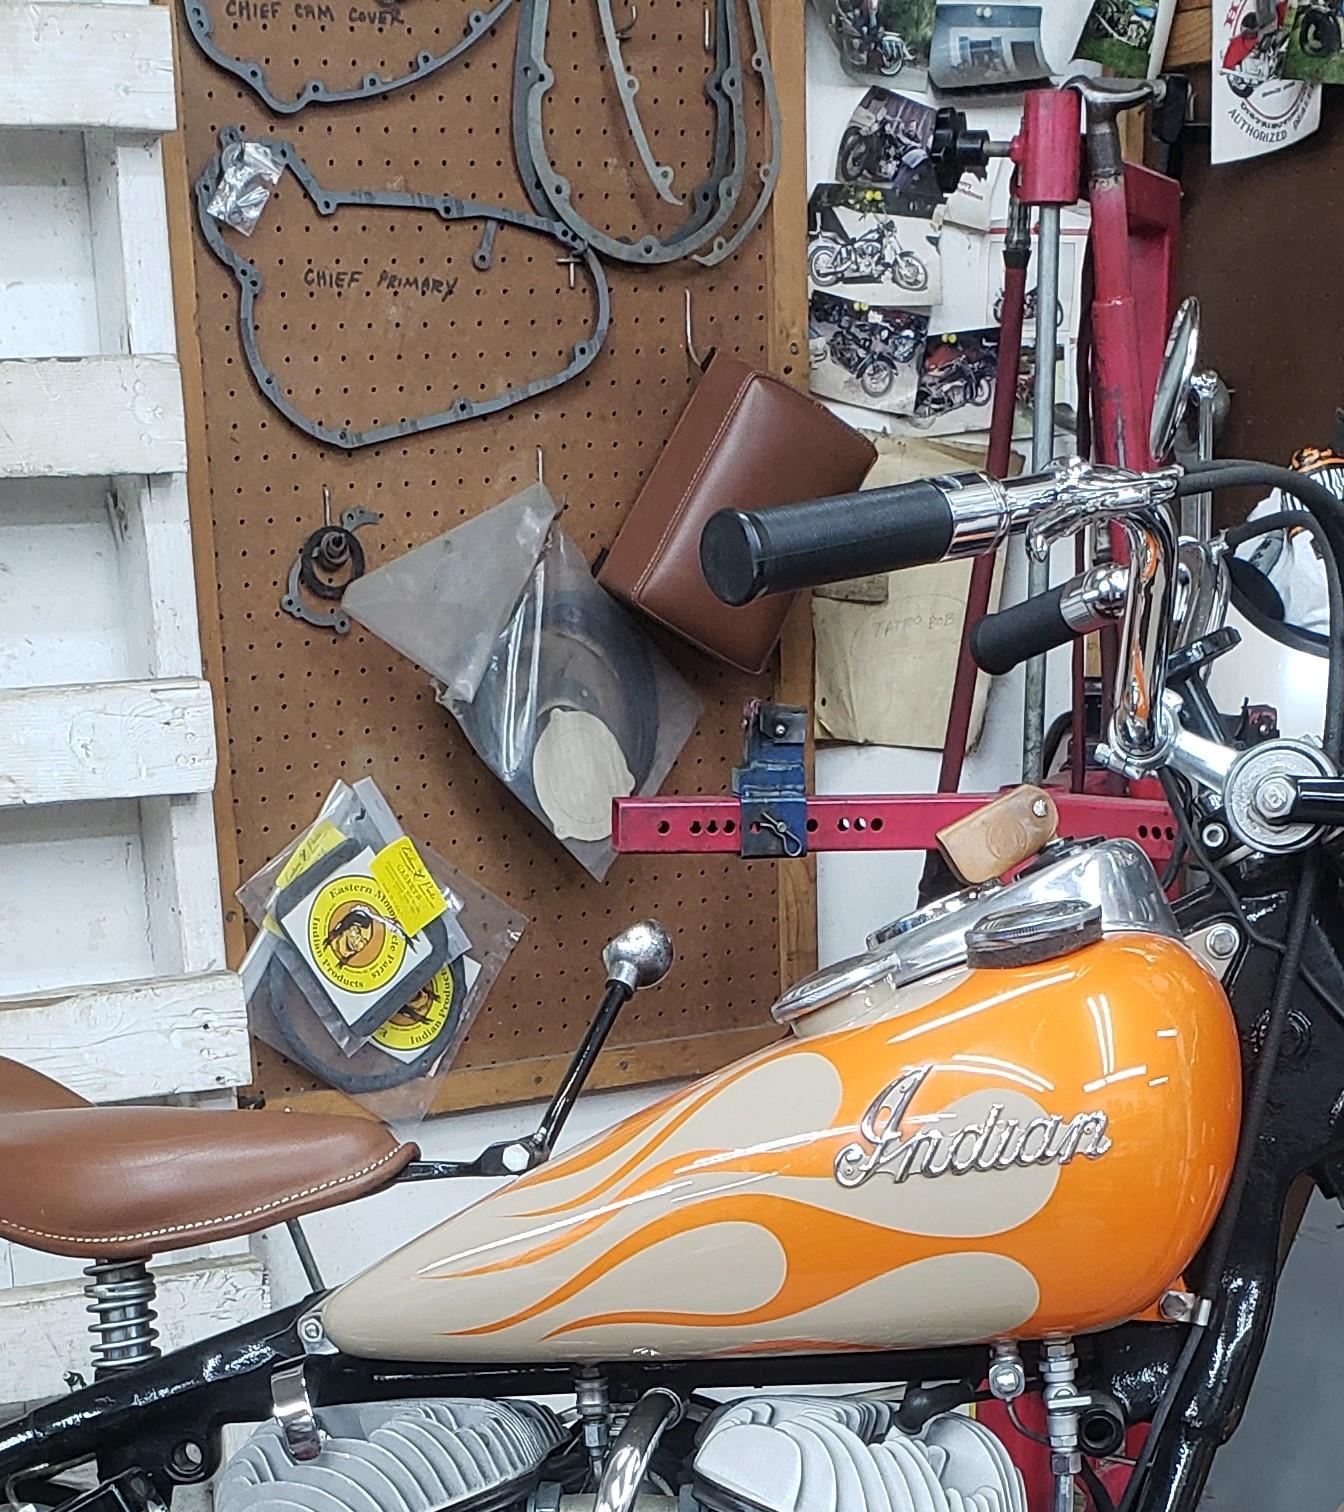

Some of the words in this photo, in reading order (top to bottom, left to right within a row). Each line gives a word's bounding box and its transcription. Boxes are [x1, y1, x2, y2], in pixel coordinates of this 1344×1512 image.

[225, 0, 282, 21] CHIEF
[294, 3, 335, 22] CAM
[348, 7, 405, 26] COVER
[1228, 109, 1287, 143] AUTHORIZED
[304, 268, 363, 289] CHIEF
[376, 269, 458, 302] PRIMARY
[328, 883, 373, 900] Eastern
[370, 953, 395, 980] Parts
[321, 957, 365, 989] Products
[409, 1020, 442, 1045] Indian
[438, 966, 451, 1018] Product
[833, 1063, 1112, 1190] Indian
